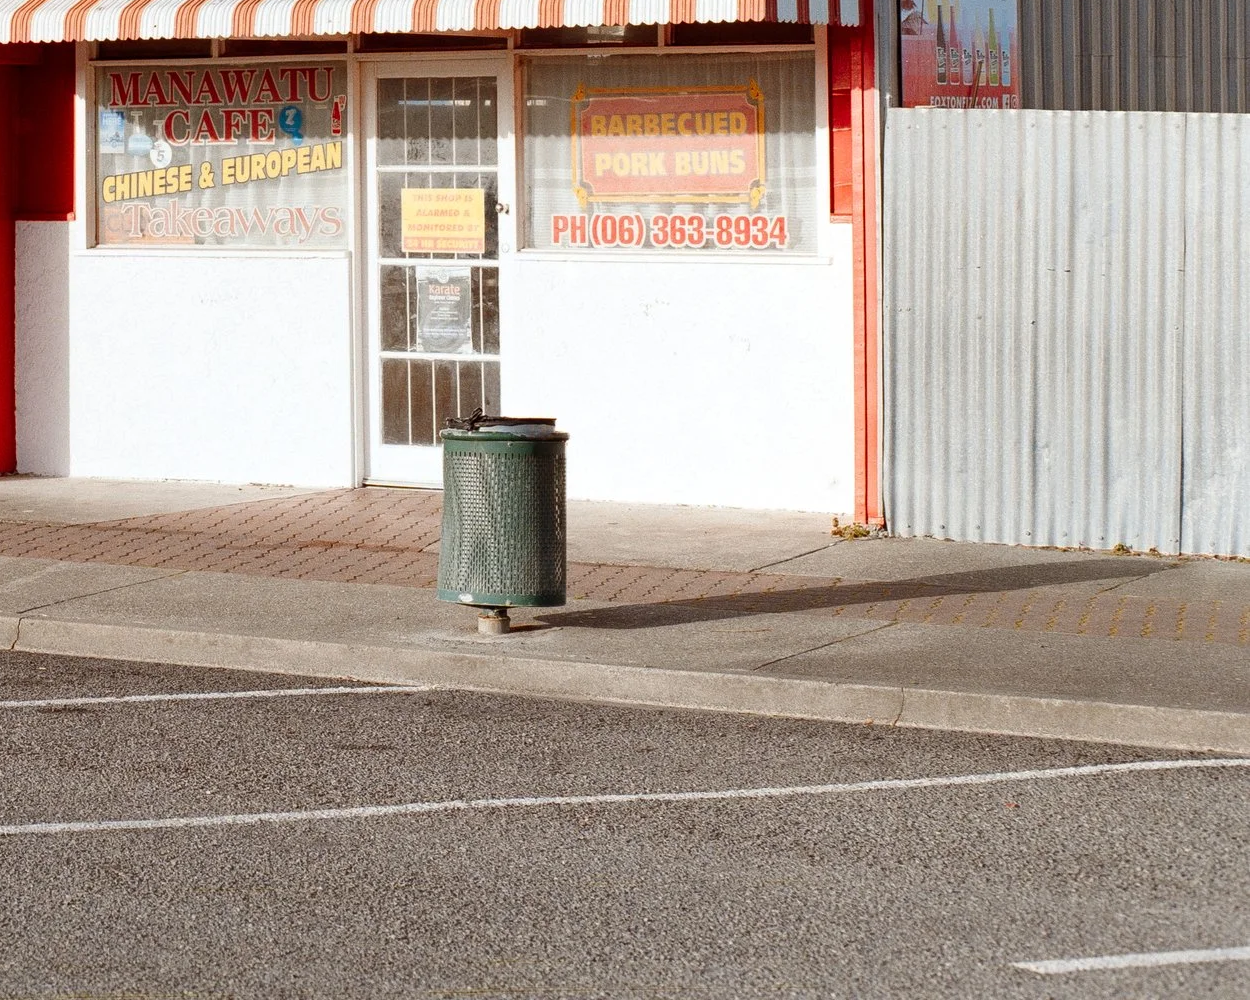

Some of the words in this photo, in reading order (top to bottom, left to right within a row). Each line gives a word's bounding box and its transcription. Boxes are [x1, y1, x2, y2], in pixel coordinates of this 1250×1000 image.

[108, 66, 334, 108] MANAWATU
[163, 106, 276, 146] CAFE
[591, 111, 748, 138] BARBECUED
[102, 163, 193, 204] CHINESE
[198, 161, 215, 190] &
[222, 140, 343, 186] EUROPEAN
[594, 149, 668, 177] PORK
[675, 149, 747, 176] BUNS
[412, 193, 433, 202] THIS
[436, 193, 462, 202] SHOP
[464, 193, 474, 202] IS
[121, 198, 343, 244] Takeaways
[415, 208, 460, 217] ALARMED
[407, 223, 464, 232] MONITORED
[466, 223, 480, 232] BY
[651, 213, 788, 247] 363-8934
[428, 284, 461, 295] Karate
